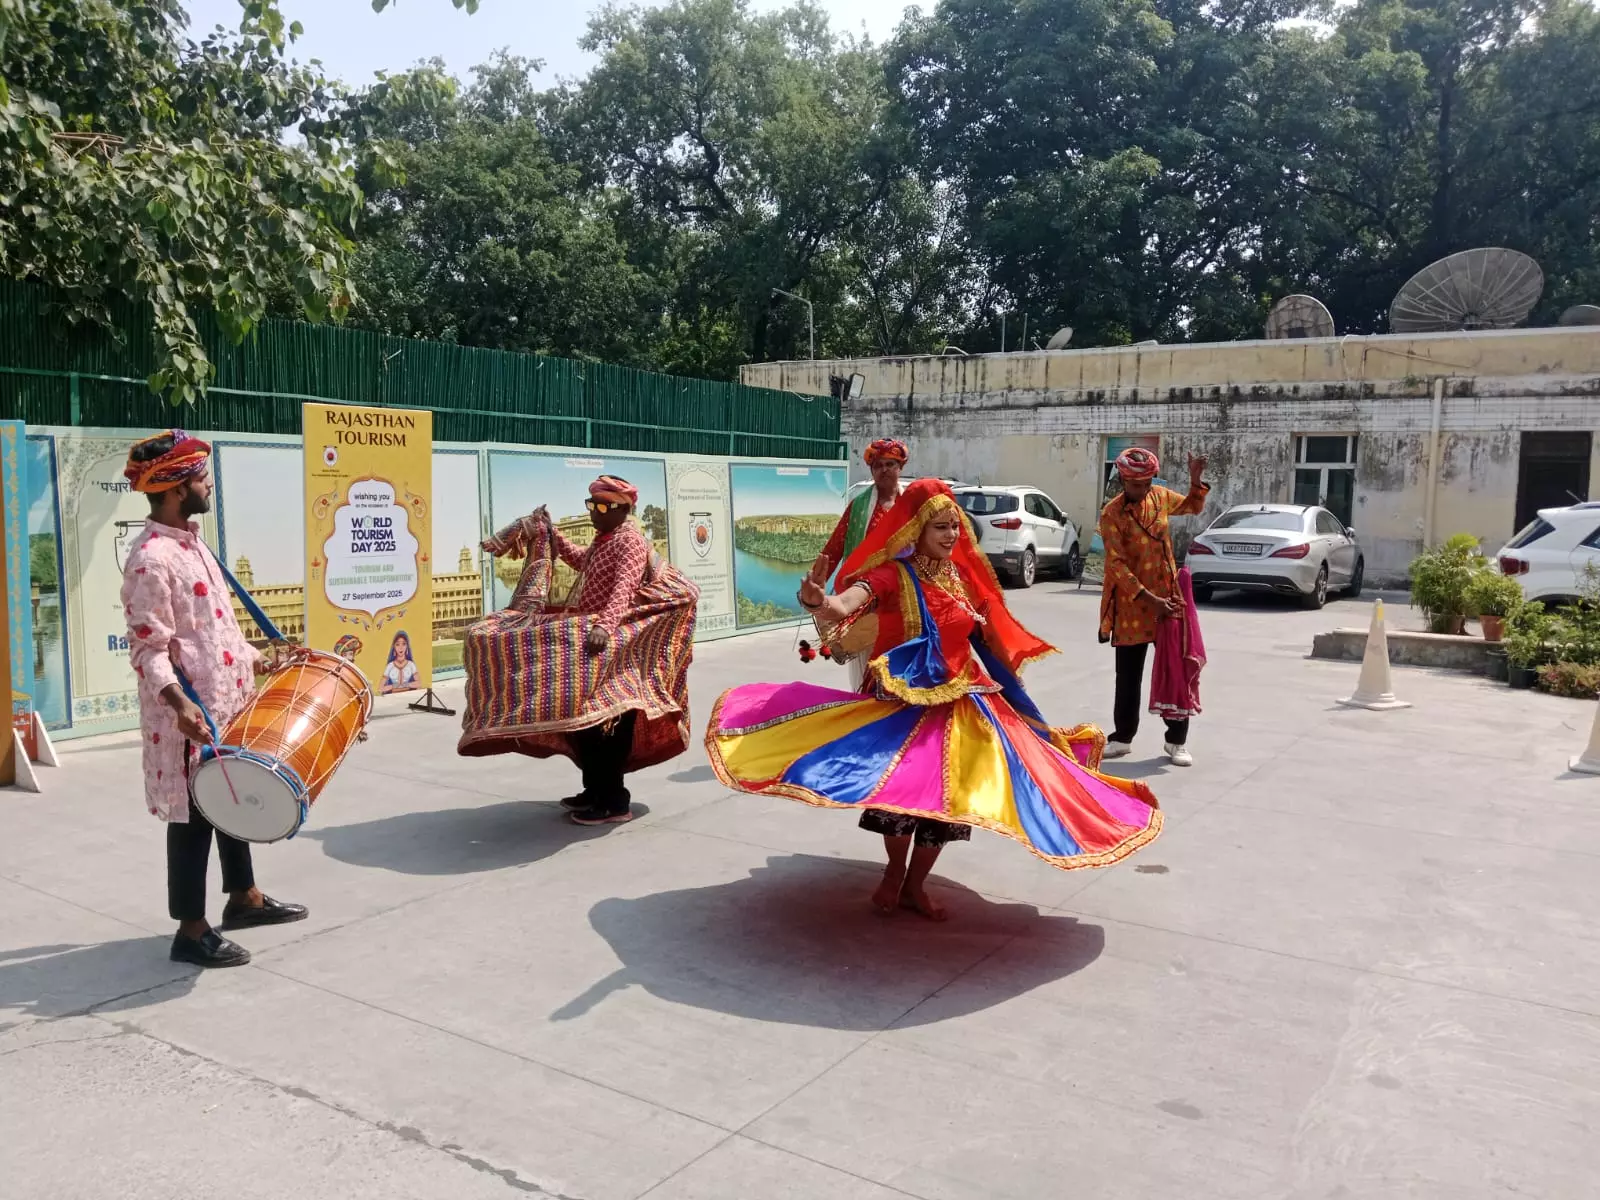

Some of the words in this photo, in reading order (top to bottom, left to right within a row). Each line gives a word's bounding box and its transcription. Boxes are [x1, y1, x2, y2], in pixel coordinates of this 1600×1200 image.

[325, 410, 415, 429] RAJASTHAN
[335, 430, 407, 448] TOURISM
[354, 492, 377, 502] wishing
[378, 494, 390, 502] you
[351, 515, 392, 528] WORLD
[351, 528, 394, 541] TOURISM
[351, 542, 372, 553] DAY
[374, 541, 396, 552] 2025
[342, 593, 351, 602] 27
[352, 591, 386, 602] September
[387, 589, 403, 598] 2025
[107, 634, 129, 651] Ra
